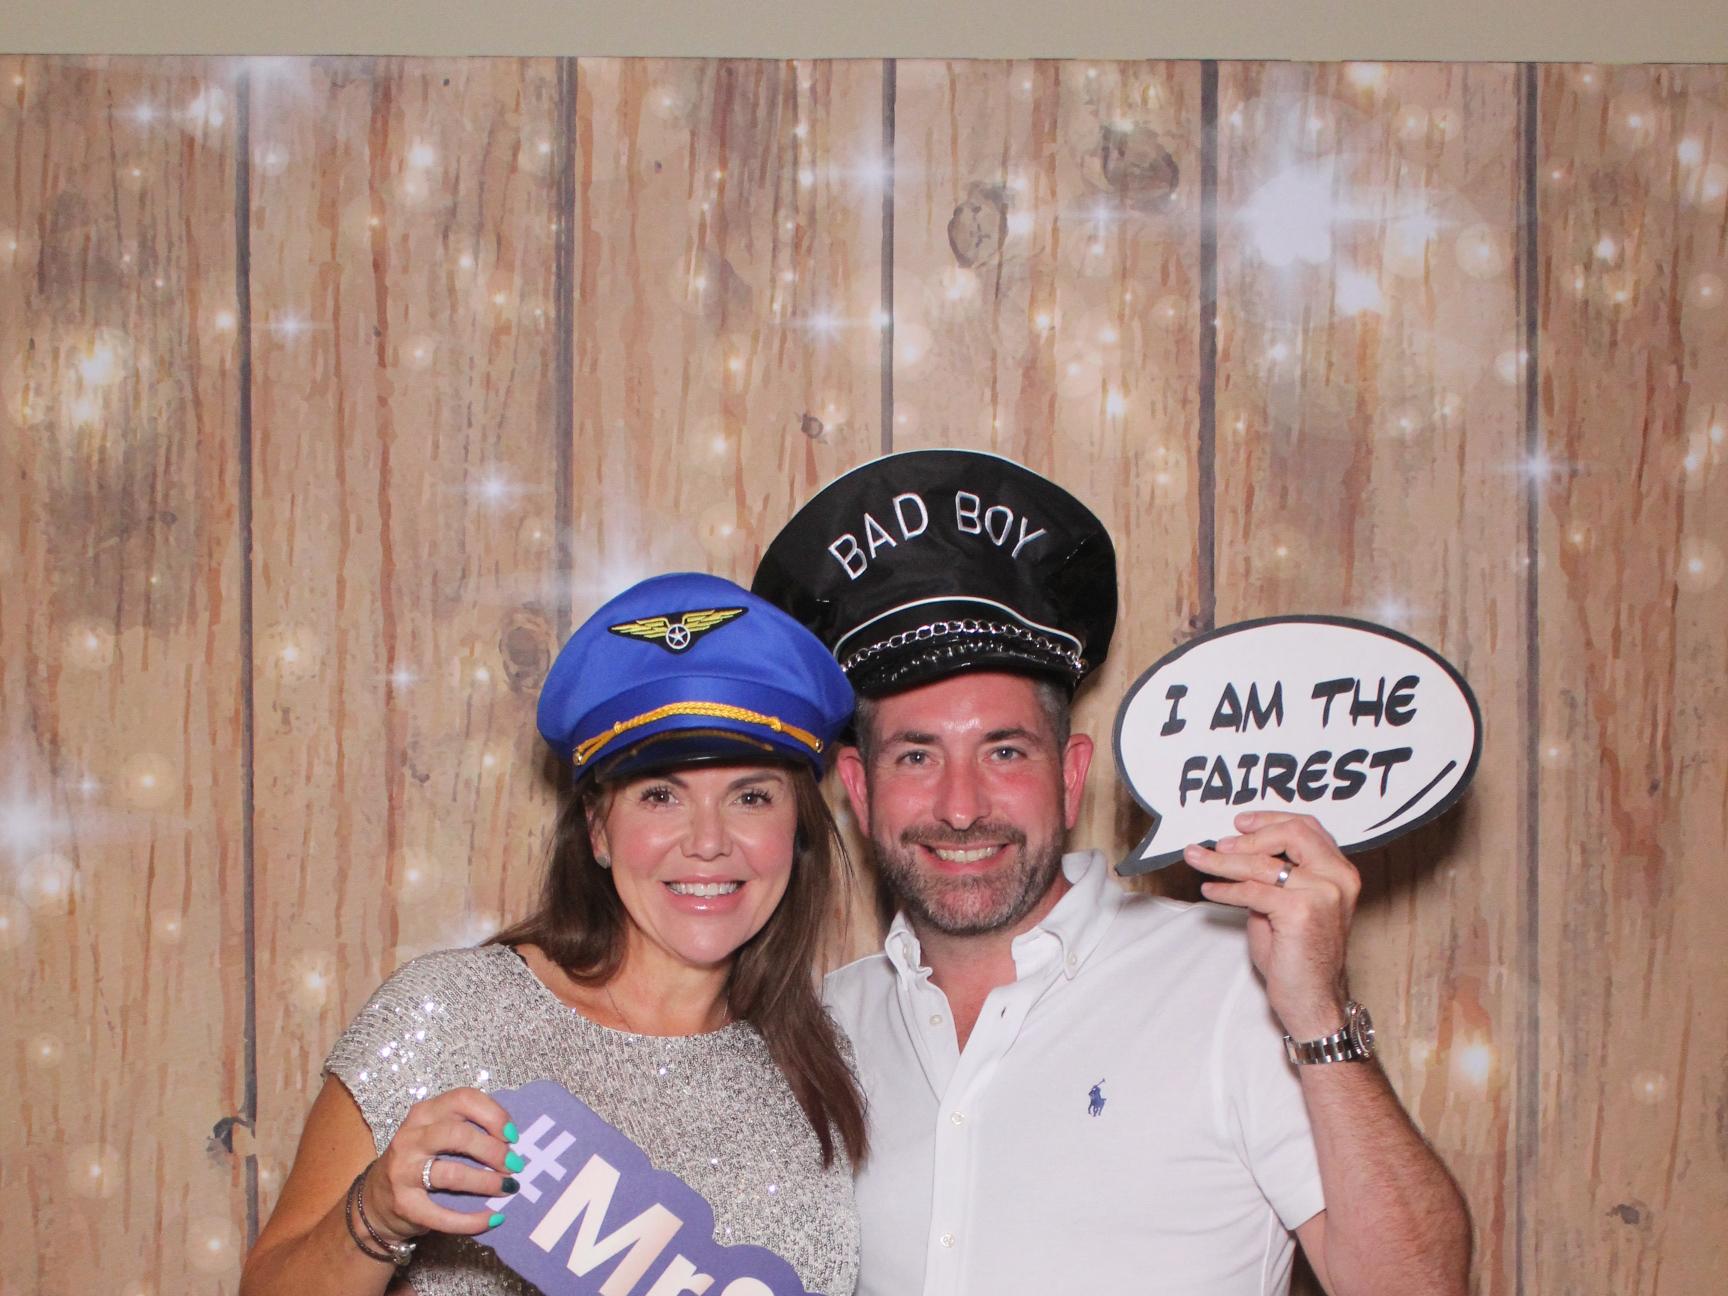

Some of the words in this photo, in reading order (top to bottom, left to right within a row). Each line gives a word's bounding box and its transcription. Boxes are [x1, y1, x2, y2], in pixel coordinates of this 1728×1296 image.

[827, 492, 930, 581] BAD
[954, 489, 1048, 560] BOY
[1160, 683, 1188, 737] I
[1209, 680, 1284, 734] AM
[1311, 674, 1421, 729] THE
[1178, 746, 1413, 808] FAIREST
